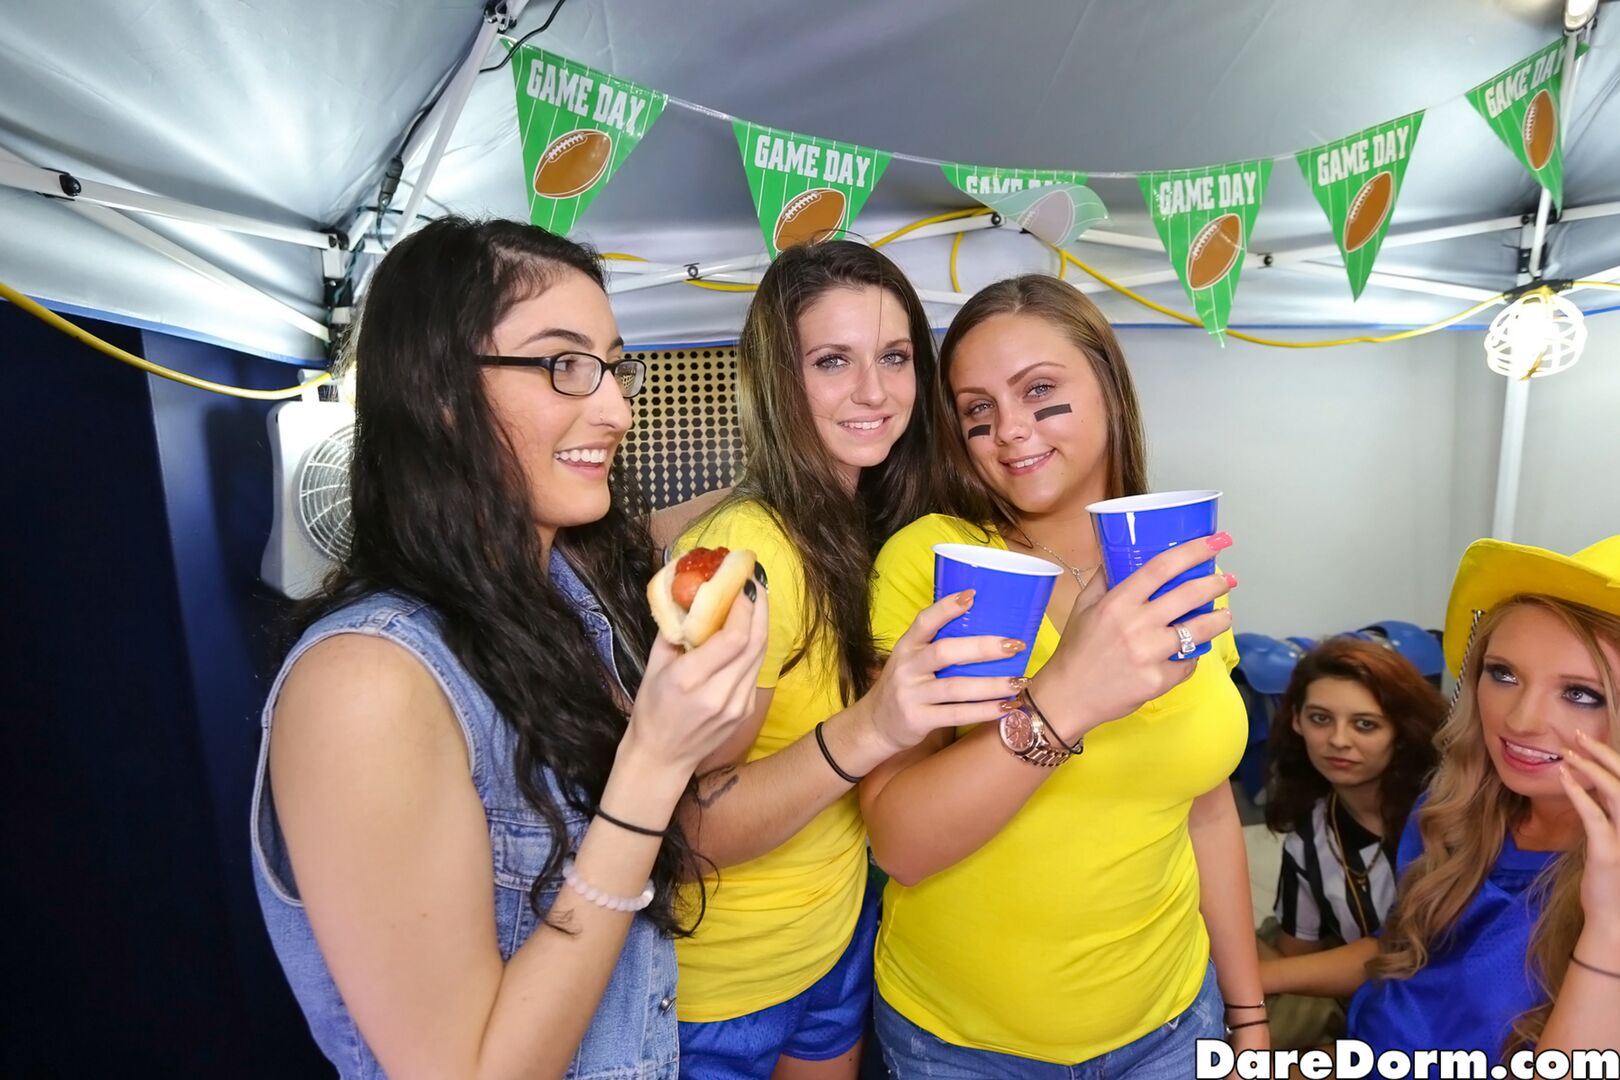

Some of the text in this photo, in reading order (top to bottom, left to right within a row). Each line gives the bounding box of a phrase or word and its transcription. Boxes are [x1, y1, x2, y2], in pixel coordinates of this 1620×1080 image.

[526, 58, 646, 135] GAME DAY
[1484, 63, 1532, 119] GAME
[754, 134, 871, 188] GAME DAY
[1317, 125, 1410, 187] GAME DAY
[1159, 171, 1257, 216] GAME DAY
